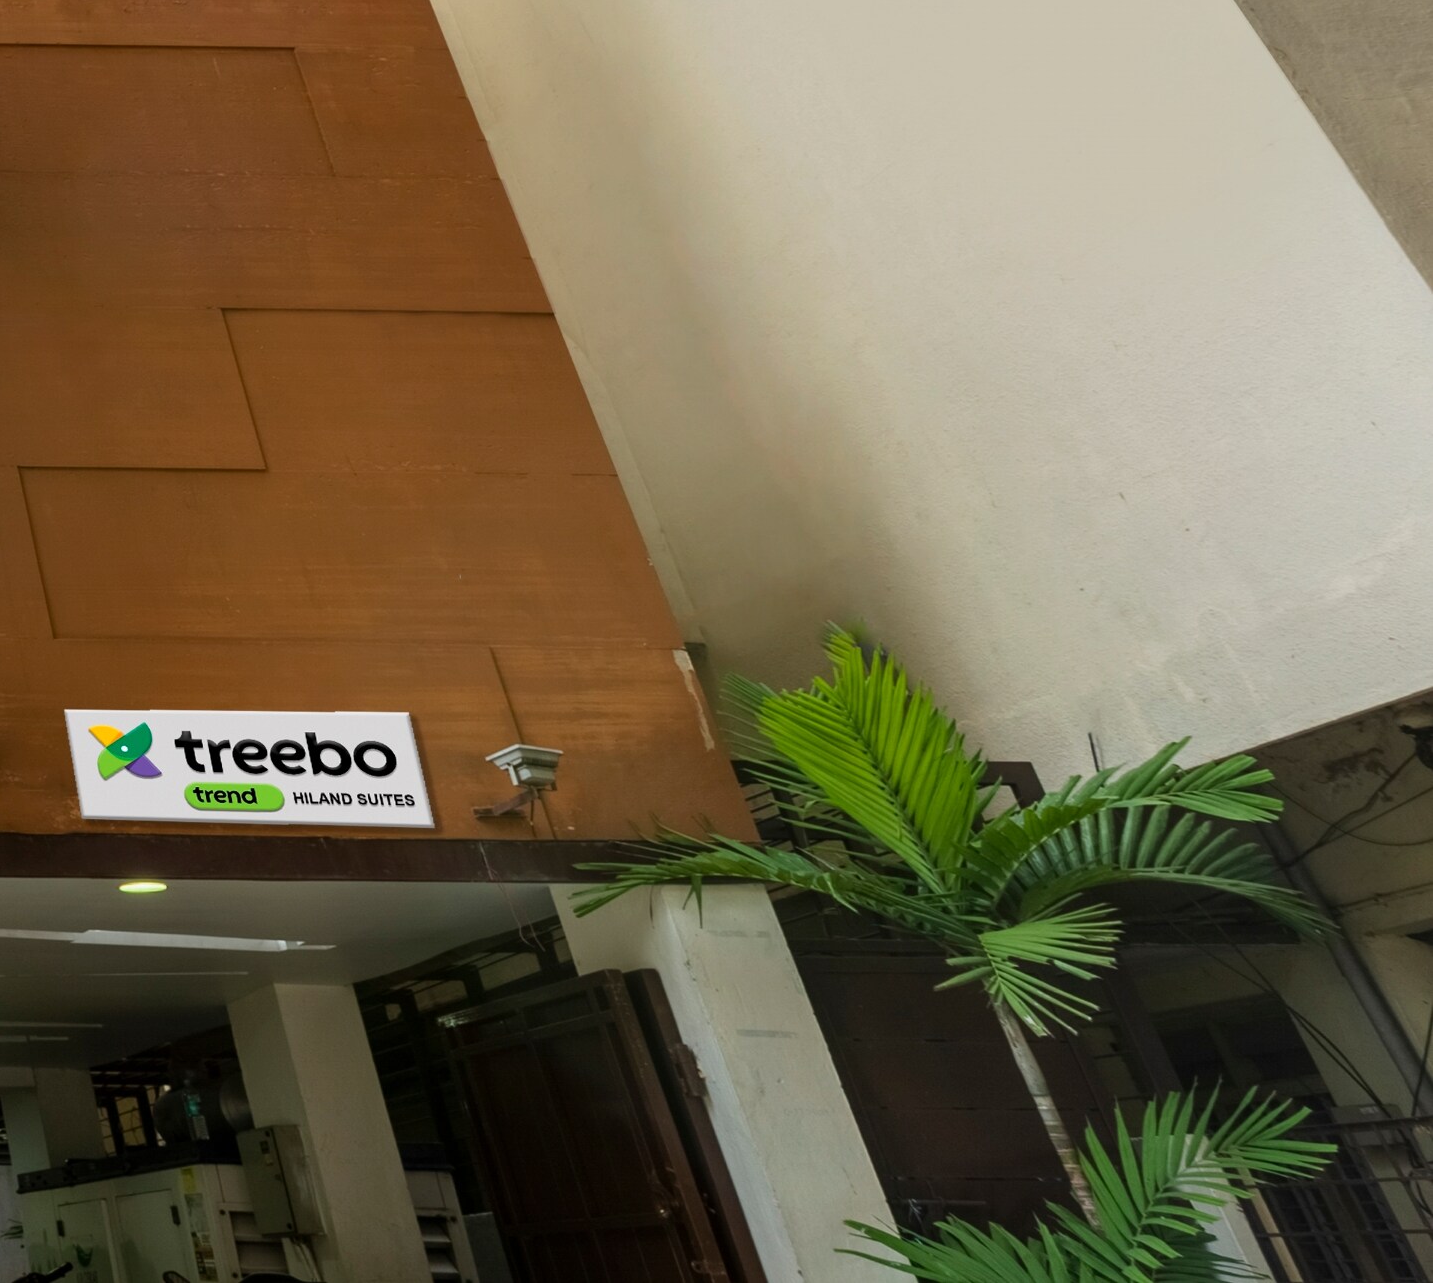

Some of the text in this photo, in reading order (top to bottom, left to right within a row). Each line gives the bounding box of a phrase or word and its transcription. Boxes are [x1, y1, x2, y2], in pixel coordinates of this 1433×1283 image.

[175, 730, 397, 777] treebo
[193, 785, 258, 805] trend
[293, 791, 415, 807] HILAND SUITES
